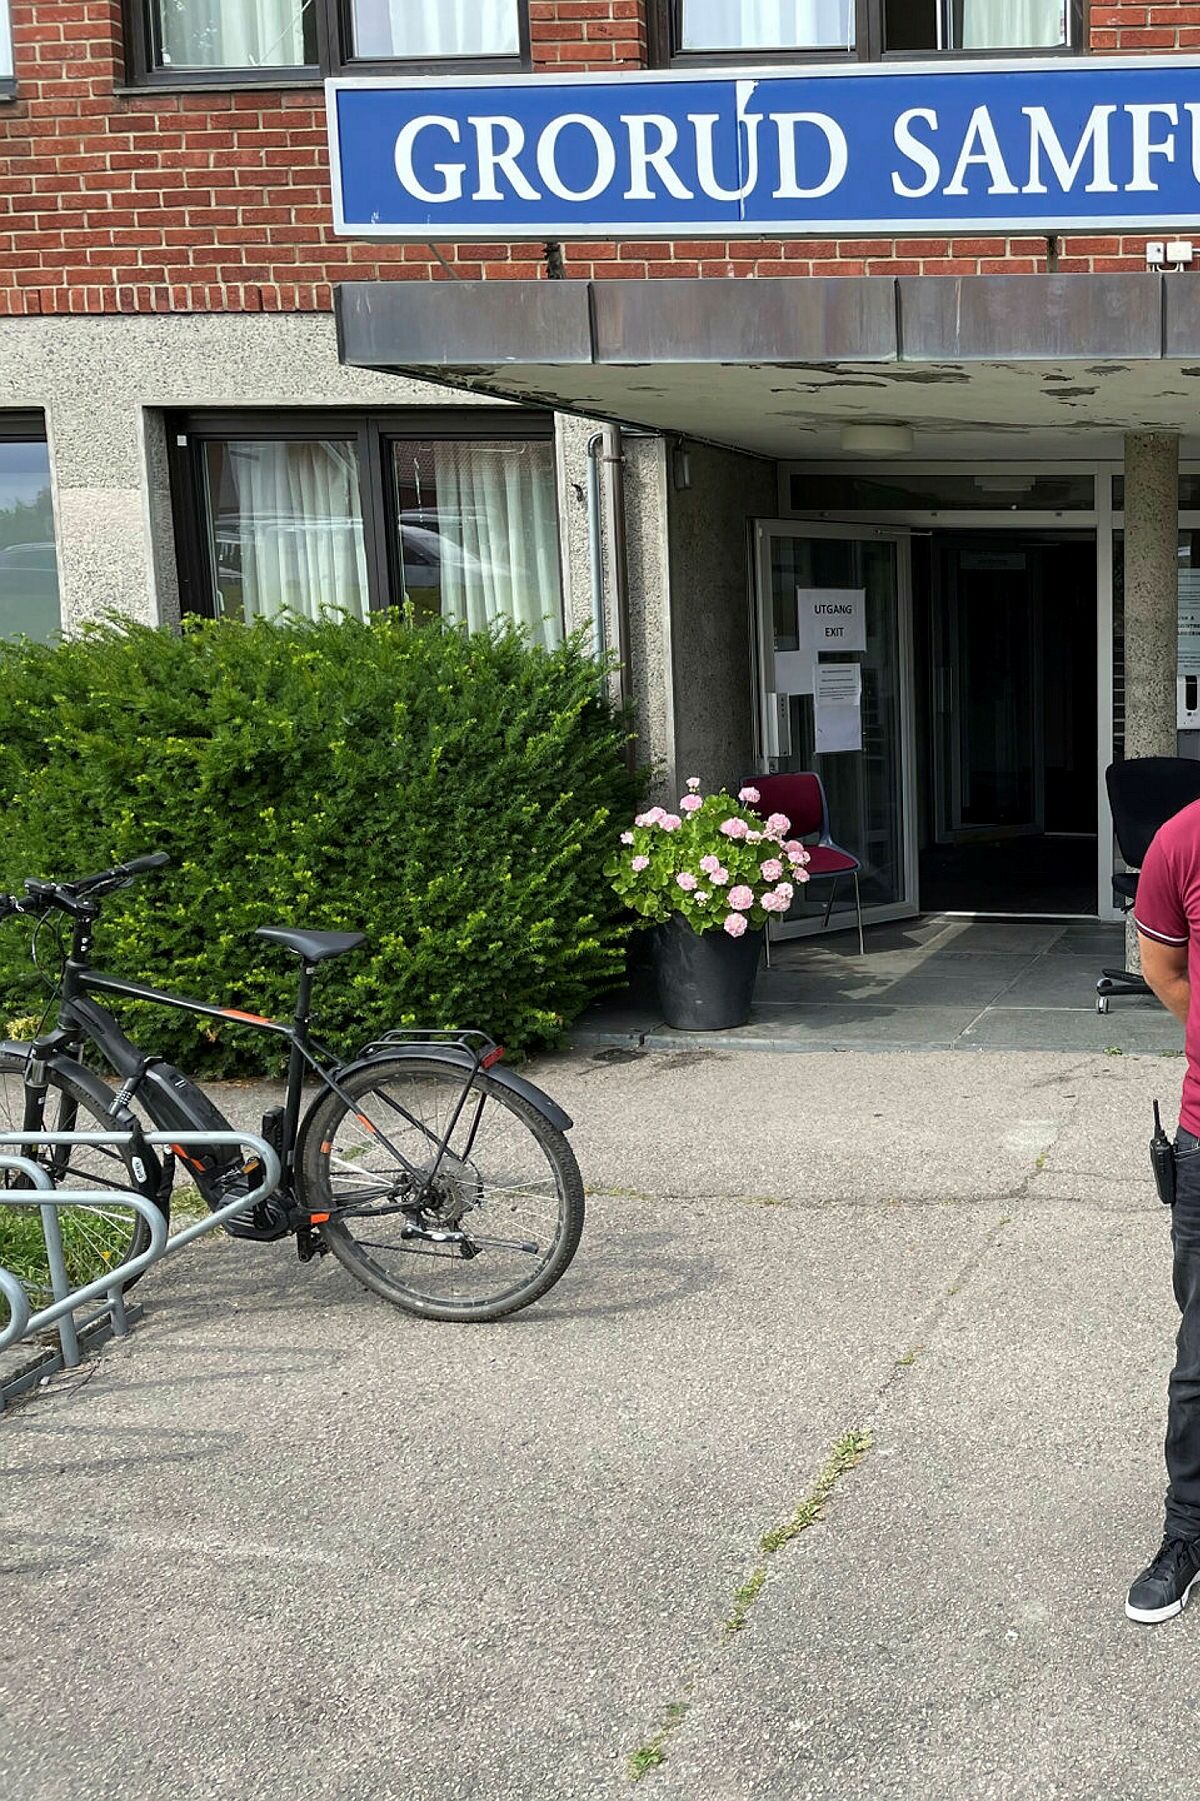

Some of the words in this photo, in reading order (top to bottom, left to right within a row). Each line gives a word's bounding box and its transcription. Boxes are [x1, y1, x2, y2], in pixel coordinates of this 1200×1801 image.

[394, 112, 848, 203] GRORUD
[814, 604, 852, 615] UTGANG
[825, 627, 844, 637] EXIT
